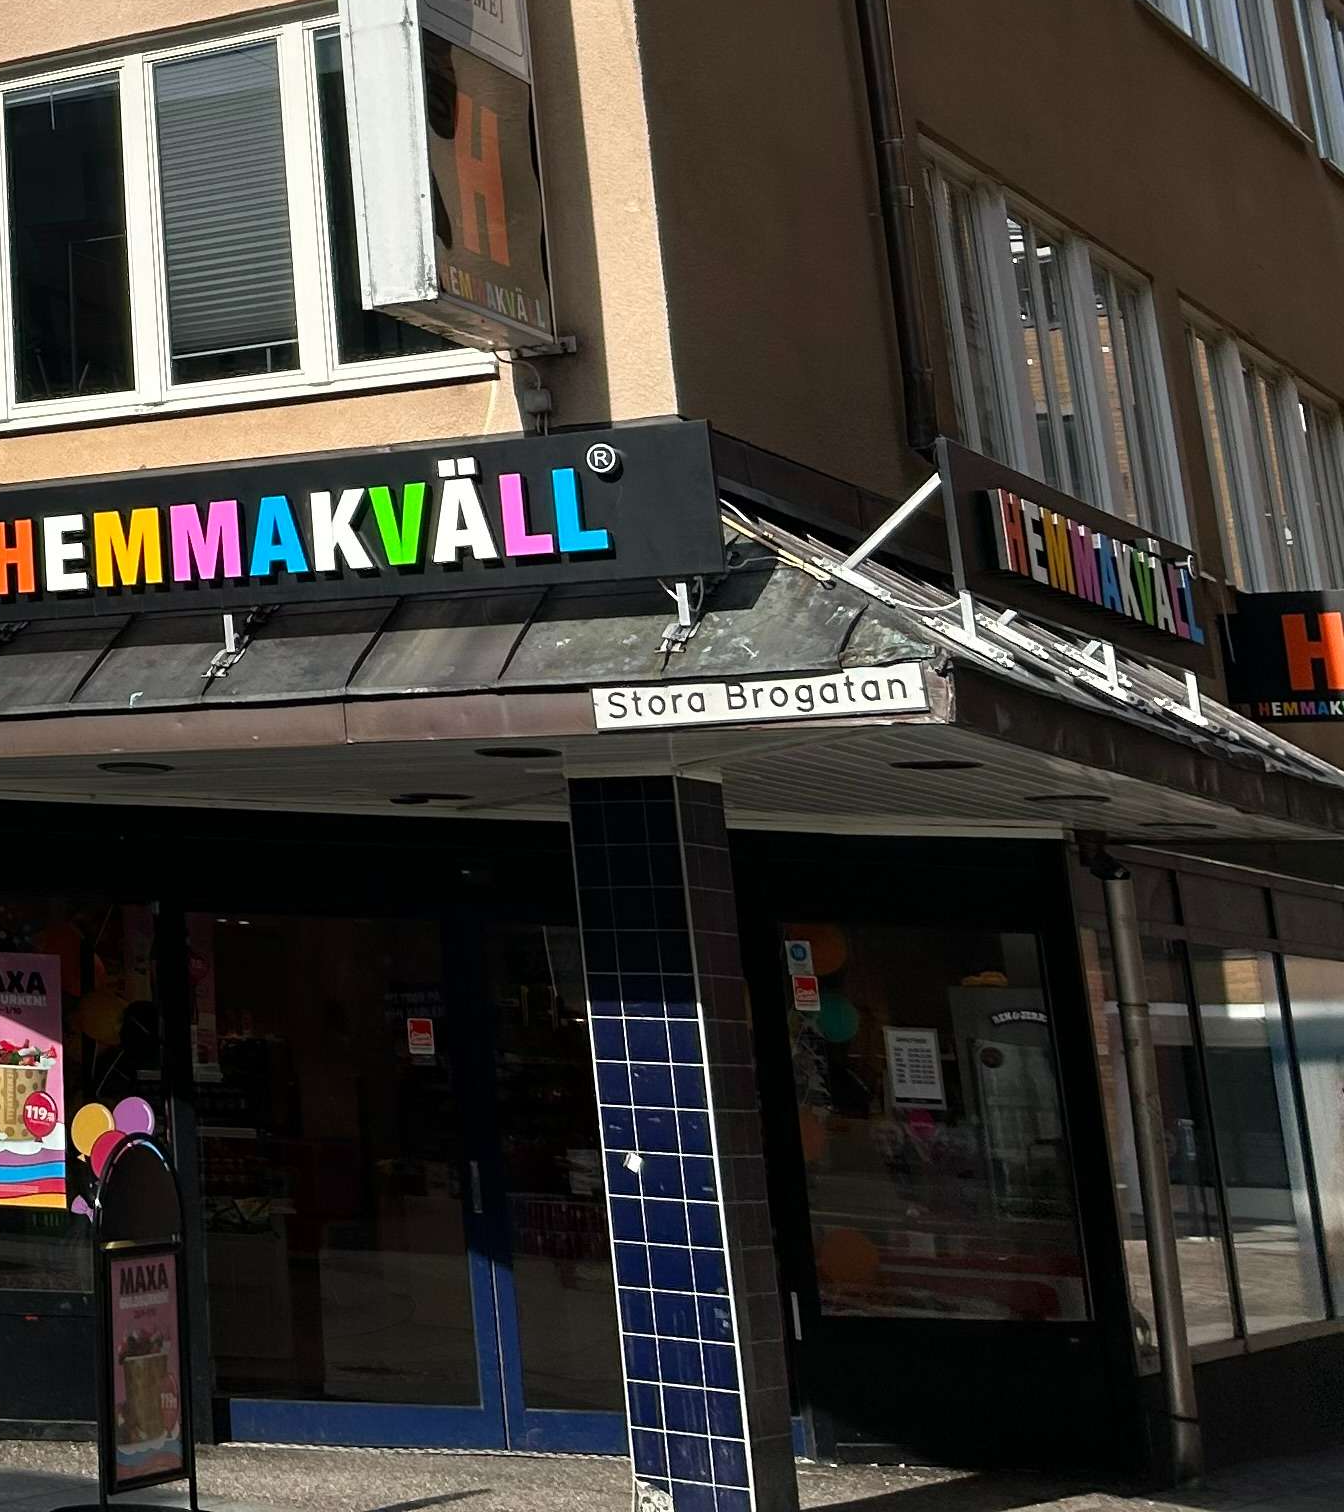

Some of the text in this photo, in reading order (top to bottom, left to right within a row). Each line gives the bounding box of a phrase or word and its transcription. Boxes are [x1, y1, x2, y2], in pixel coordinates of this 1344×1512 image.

[1280, 611, 1344, 691] H
[608, 675, 909, 720] Stora Brogatan
[1258, 699, 1344, 718] HEMMAK
[25, 1104, 48, 1121] 119
[119, 1262, 169, 1296] MAXA
